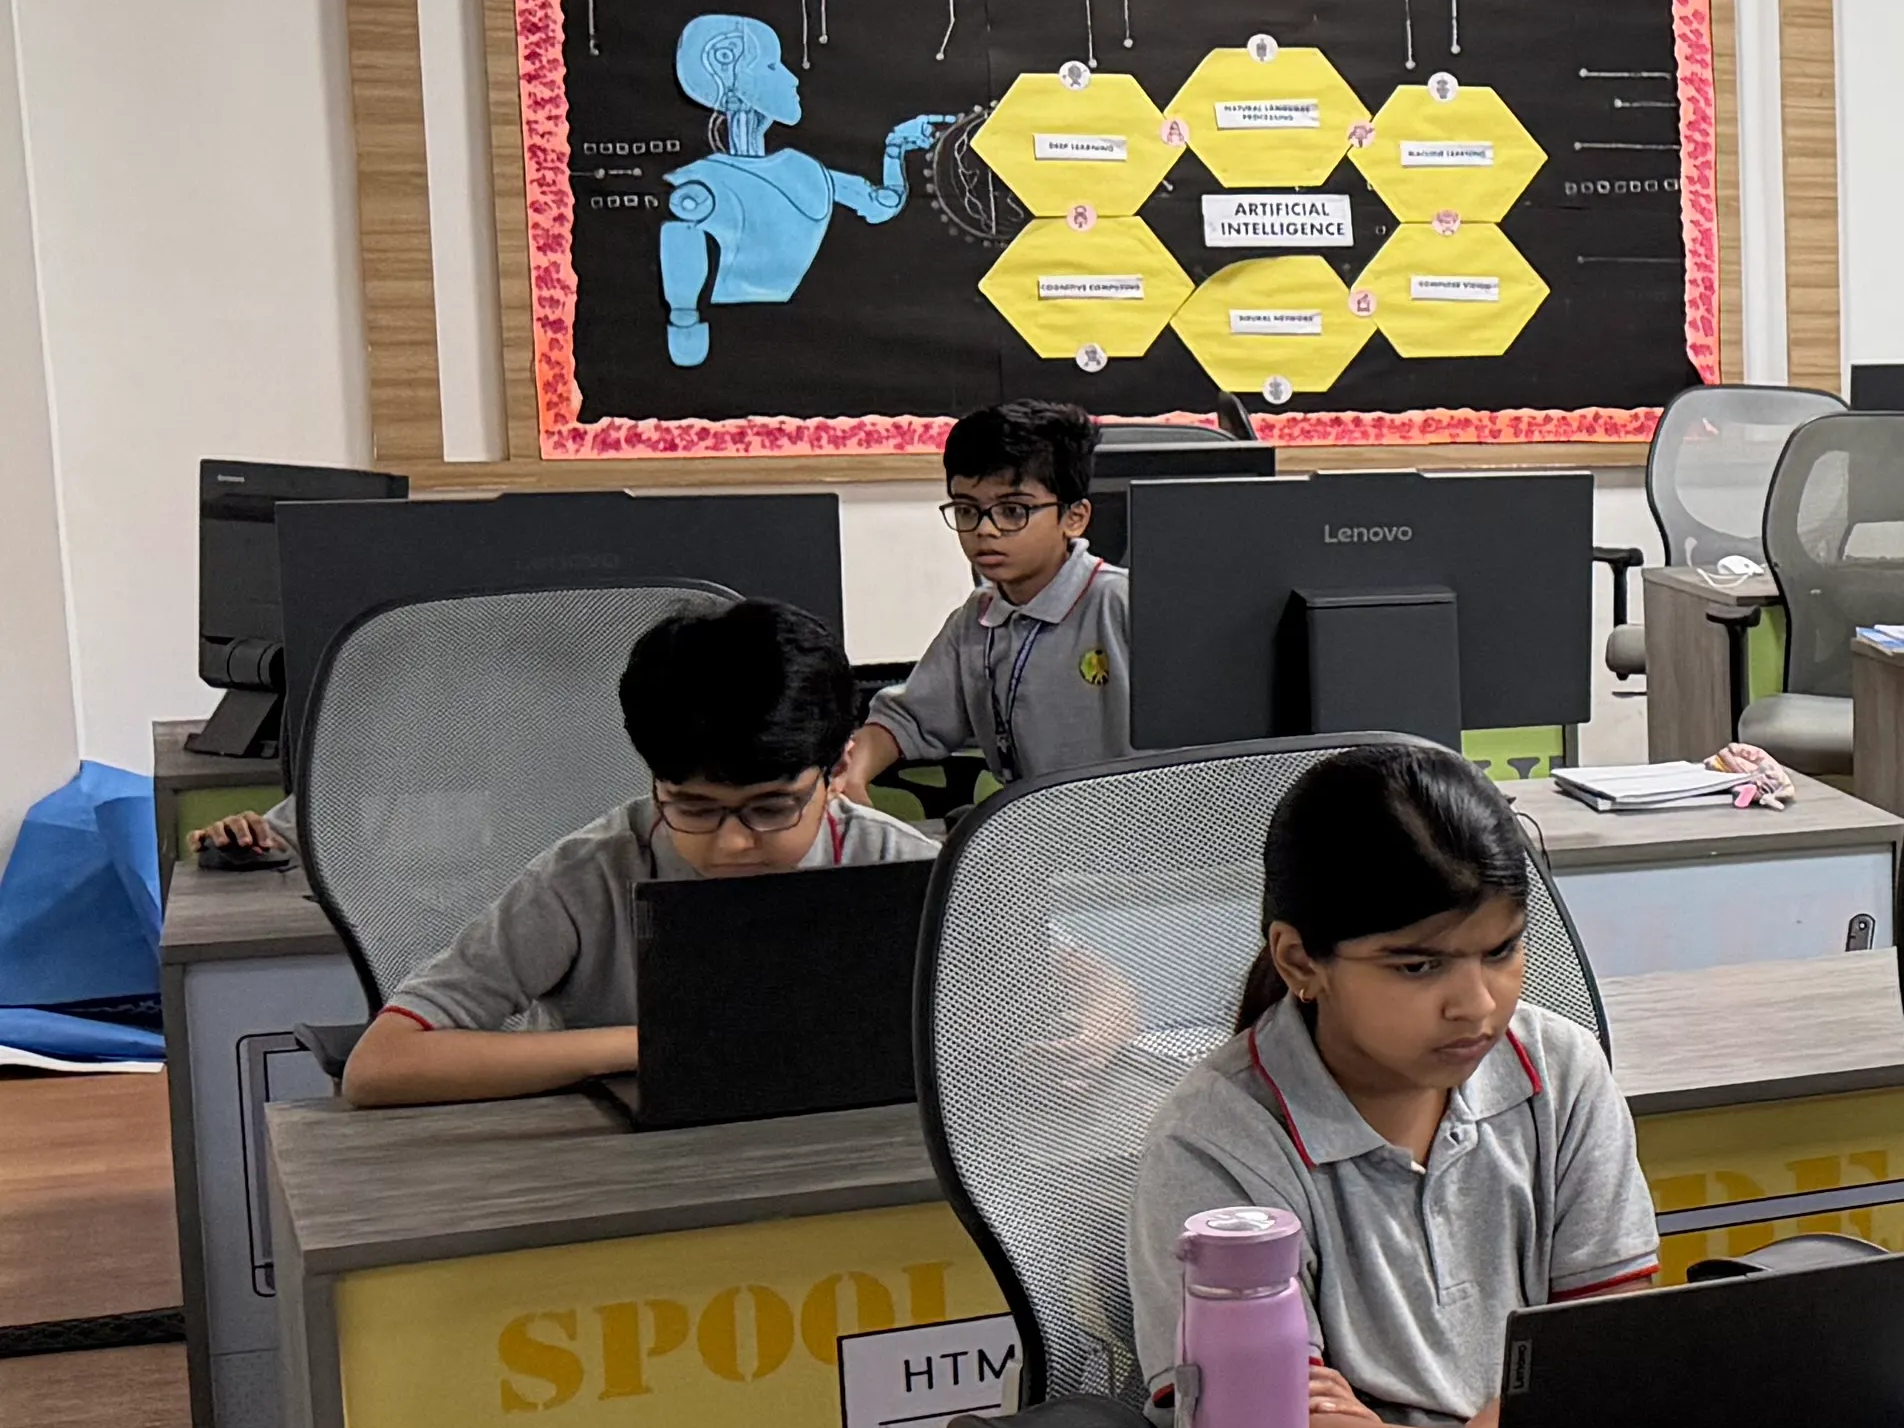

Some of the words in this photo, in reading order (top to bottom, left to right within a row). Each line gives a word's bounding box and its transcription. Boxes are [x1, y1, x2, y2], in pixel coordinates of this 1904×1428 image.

[1234, 202, 1330, 217] ARTIFICIAL
[1220, 222, 1346, 236] INTELLIGENCE
[1324, 524, 1413, 543] Lenovo
